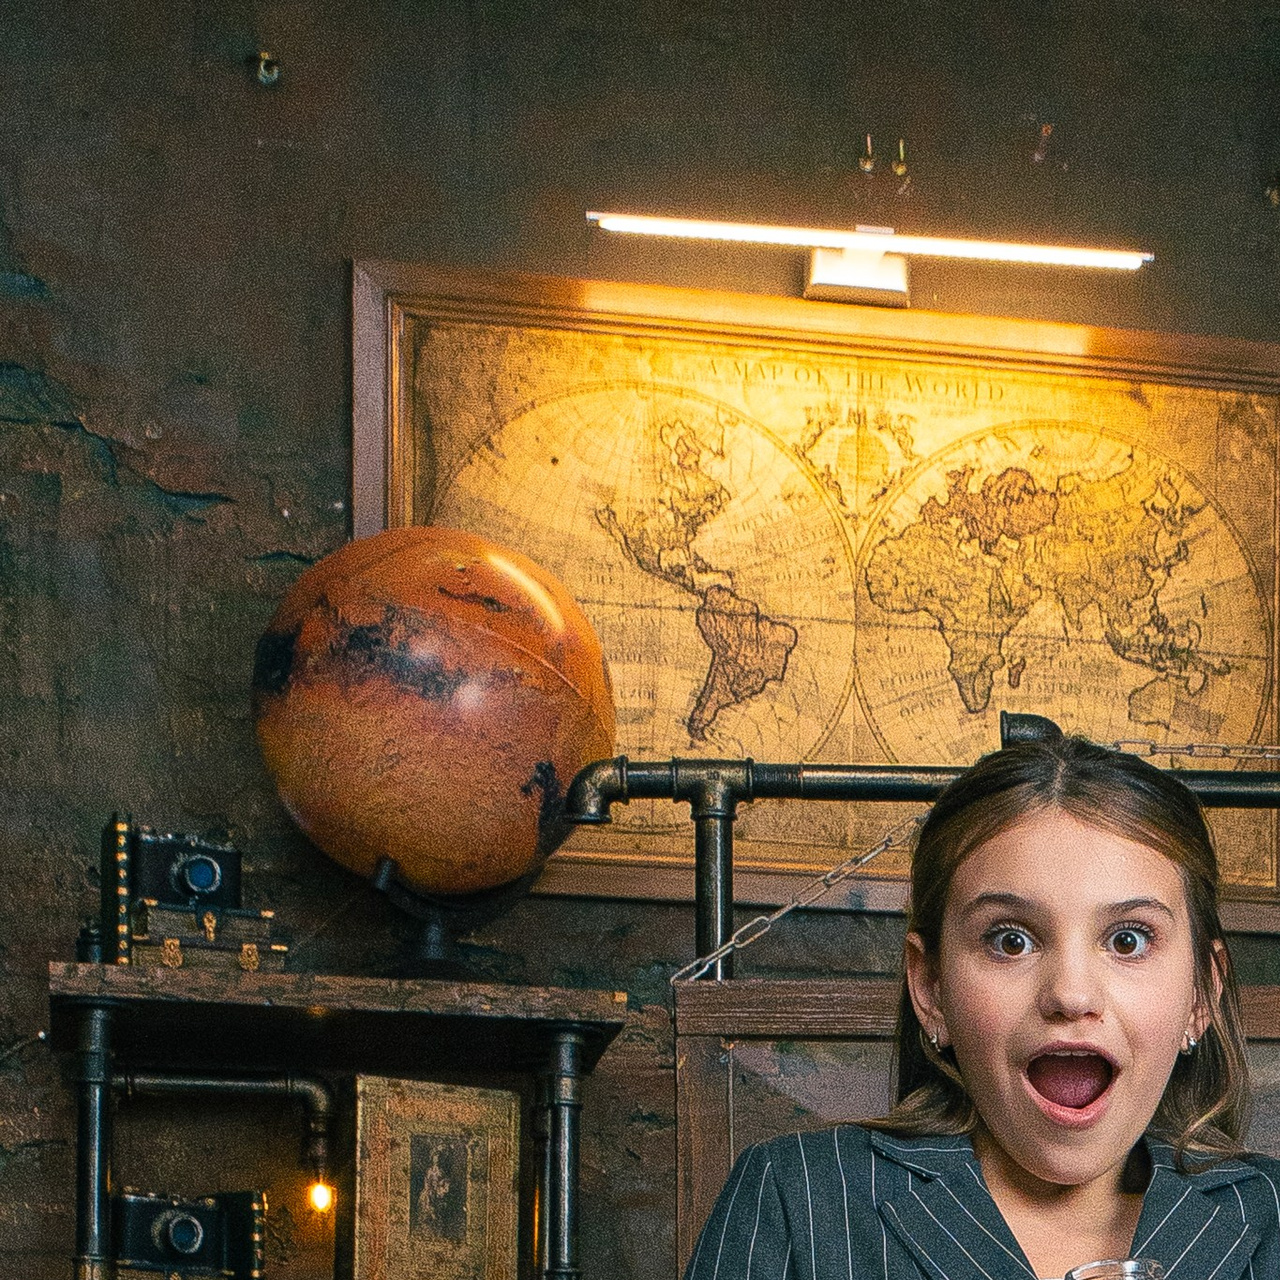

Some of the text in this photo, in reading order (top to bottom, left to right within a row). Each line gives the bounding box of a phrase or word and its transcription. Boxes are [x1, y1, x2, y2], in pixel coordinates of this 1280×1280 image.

[731, 361, 784, 381] MAP
[843, 371, 889, 391] THE
[903, 372, 1005, 401] WORLD
